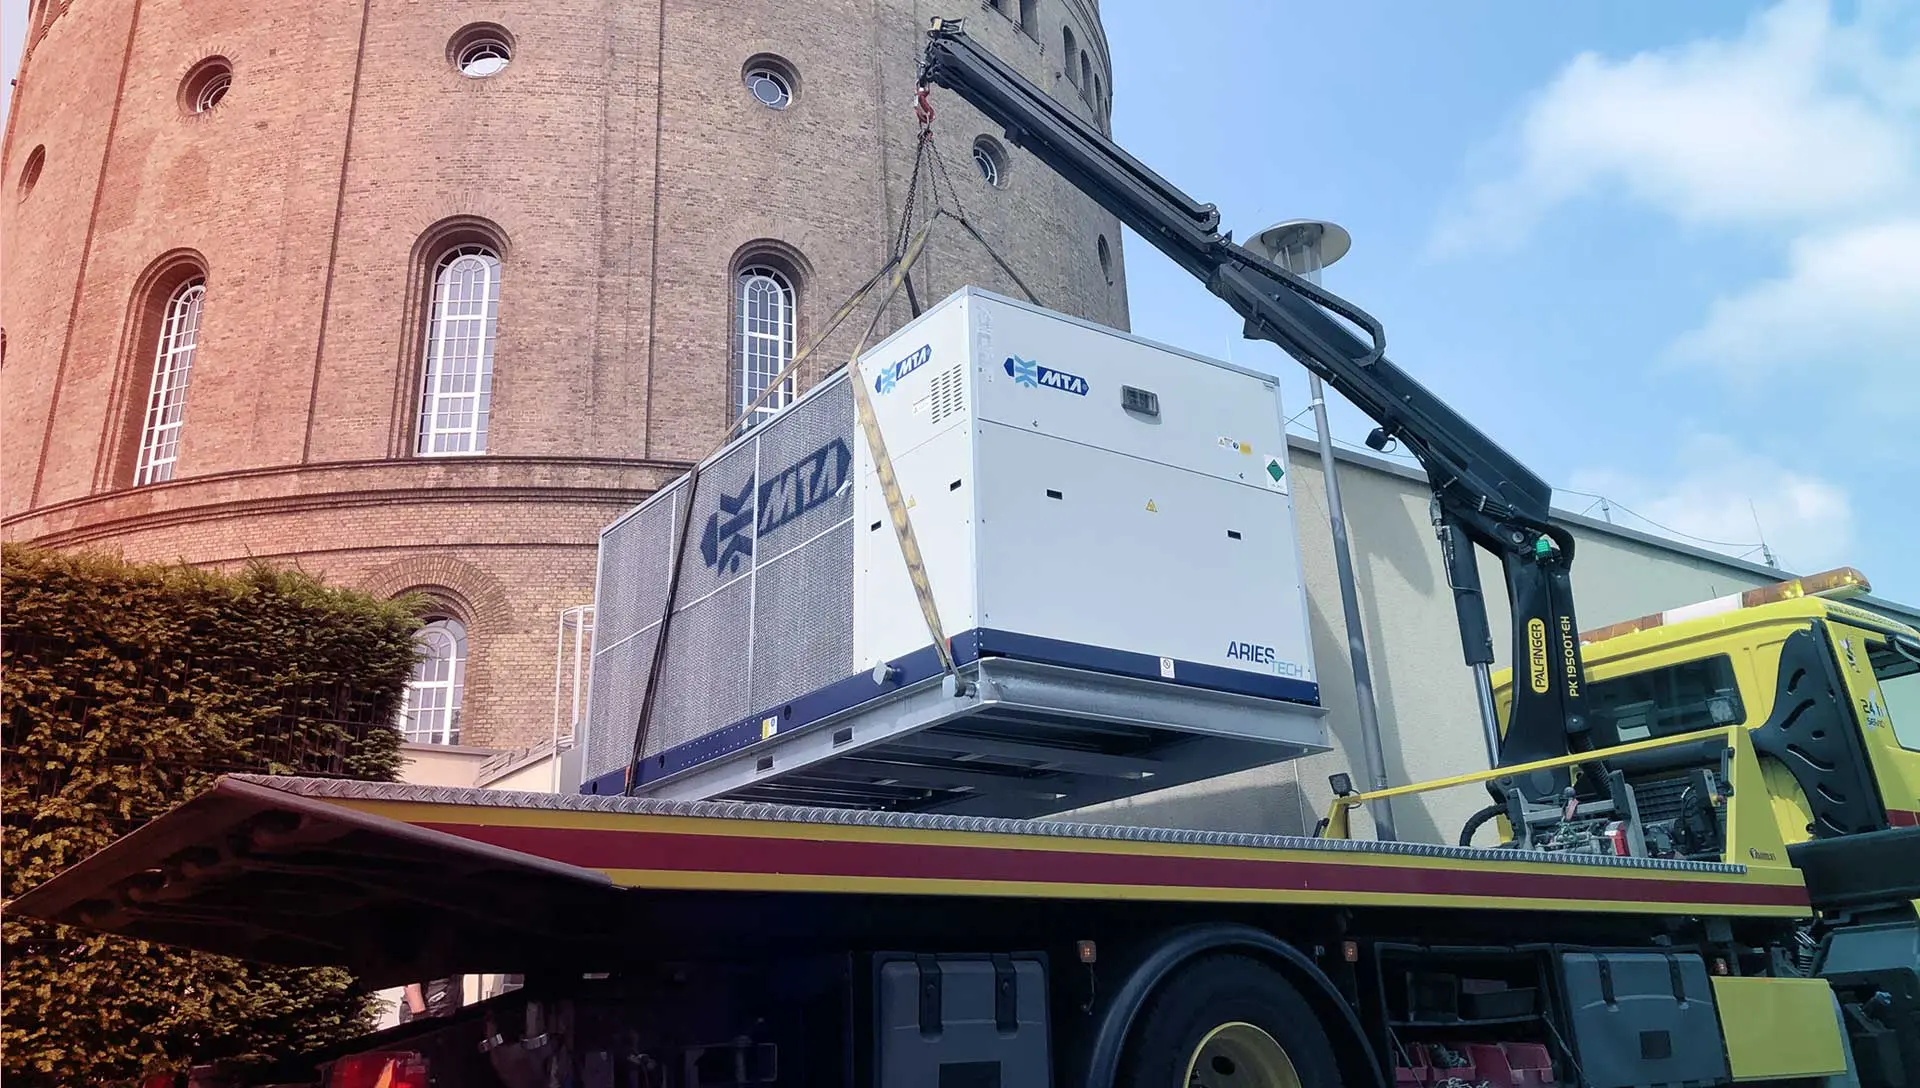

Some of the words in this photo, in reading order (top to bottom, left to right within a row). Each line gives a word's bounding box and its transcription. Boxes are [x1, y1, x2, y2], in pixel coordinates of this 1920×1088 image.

[897, 346, 927, 379] MTA
[1040, 370, 1082, 393] MTA
[758, 446, 838, 532] MTA
[1226, 640, 1275, 665] ARIES
[1531, 623, 1546, 688] PALFINGER
[1269, 659, 1303, 677] TECH
[1569, 680, 1580, 697] PK
